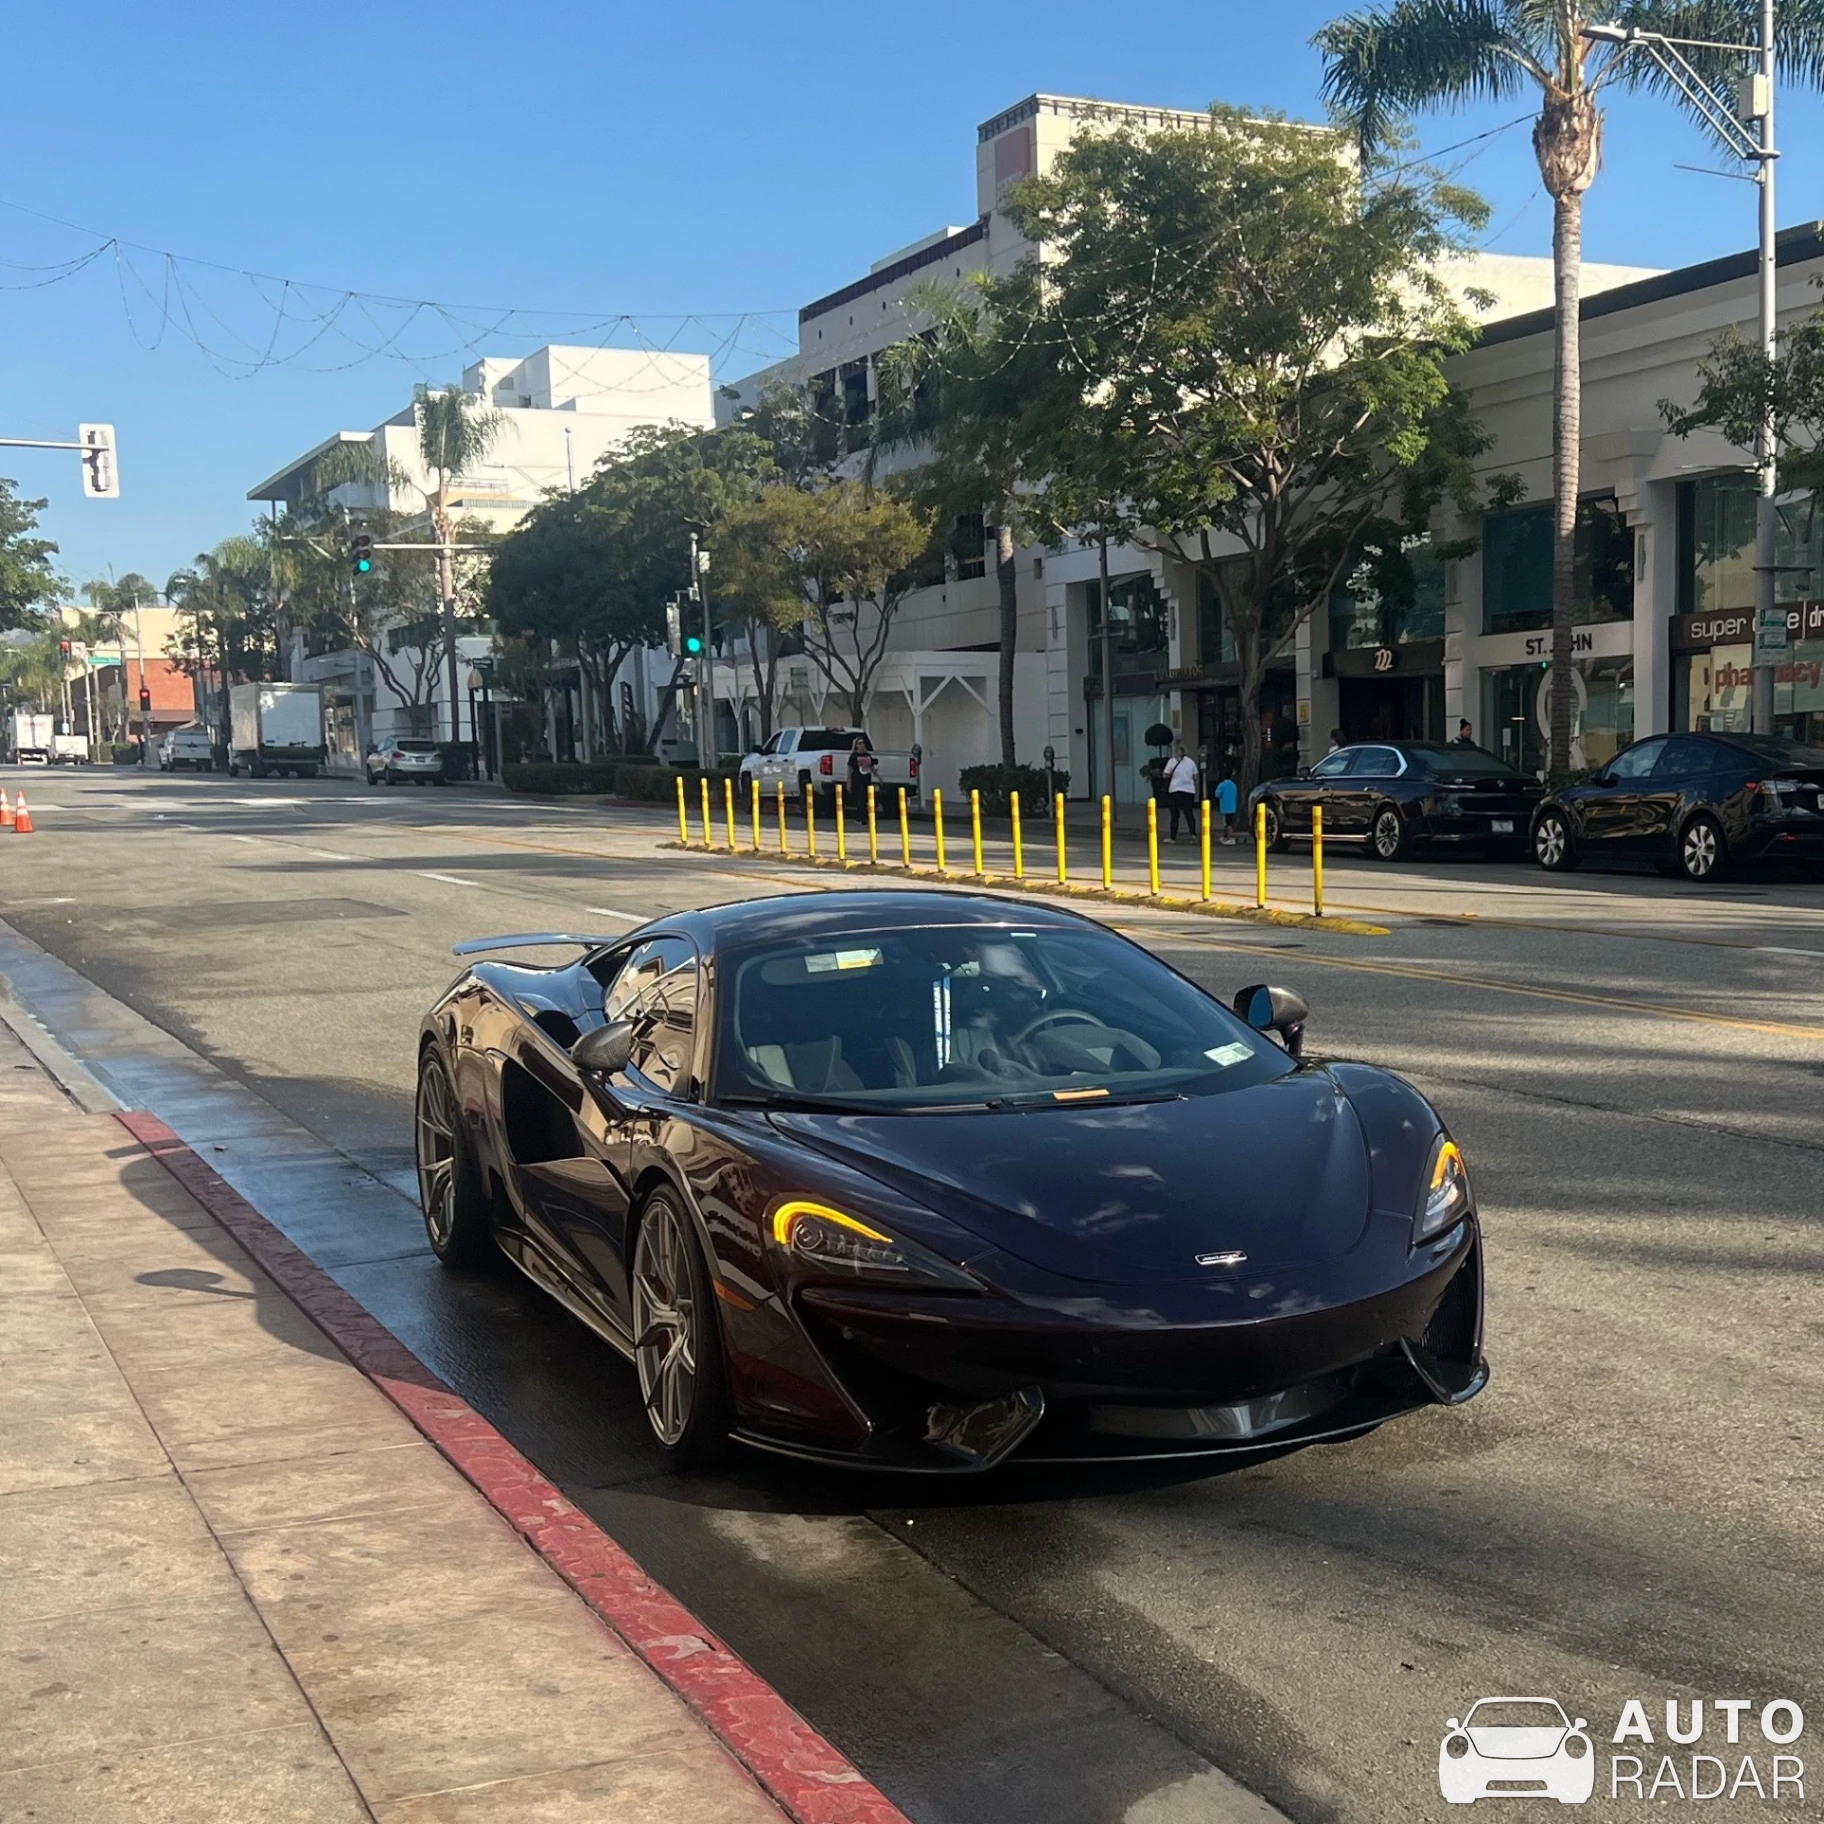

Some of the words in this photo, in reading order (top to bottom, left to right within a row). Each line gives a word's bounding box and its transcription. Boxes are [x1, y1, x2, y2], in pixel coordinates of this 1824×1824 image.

[1691, 617, 1747, 641] super
[1525, 637, 1548, 656] ST.
[1549, 632, 1592, 654] HN
